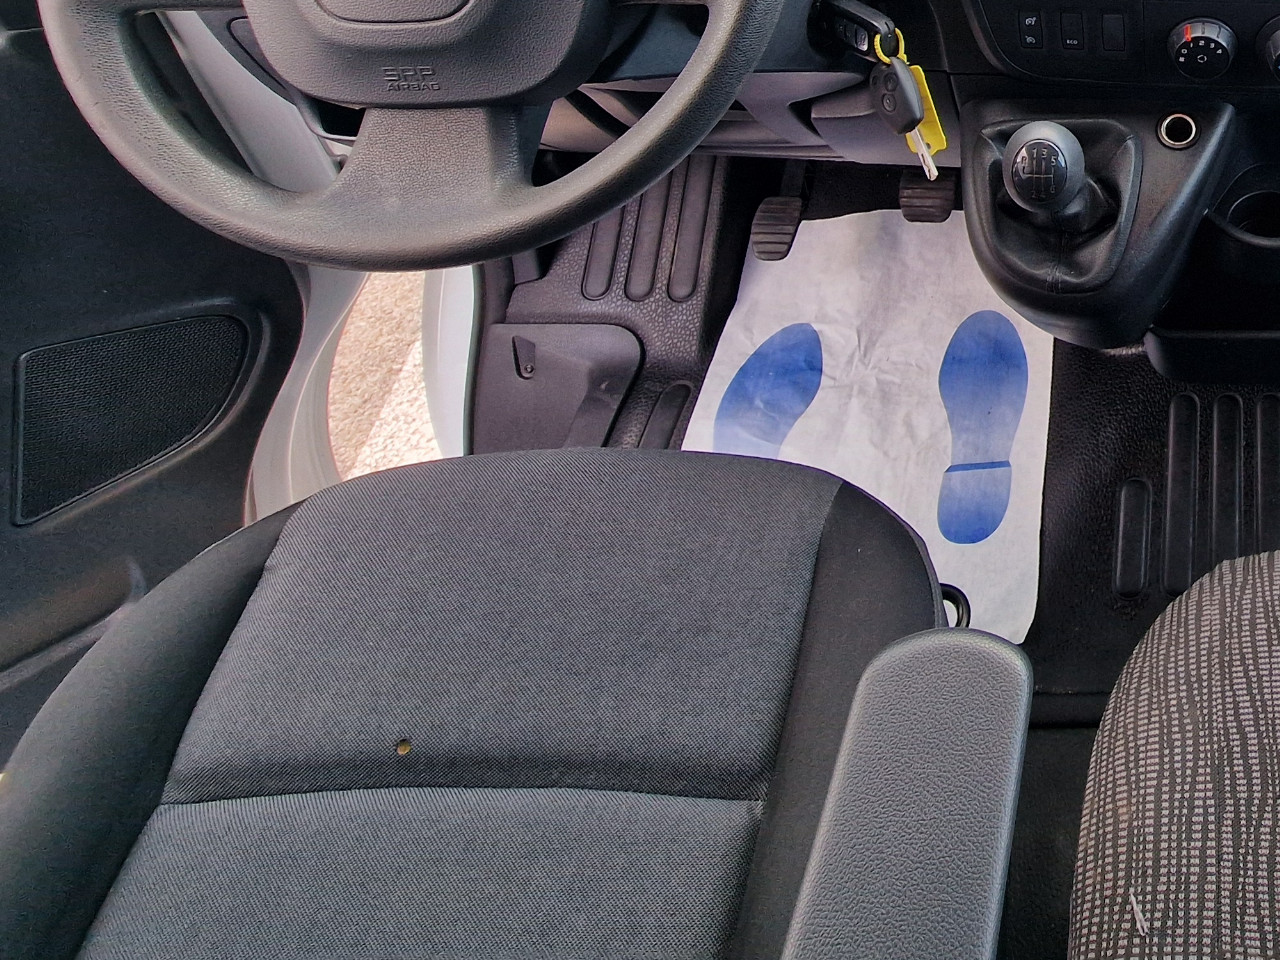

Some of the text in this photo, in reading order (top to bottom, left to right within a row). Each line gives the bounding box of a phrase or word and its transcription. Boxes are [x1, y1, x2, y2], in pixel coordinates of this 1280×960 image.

[387, 81, 440, 91] AIRBAG
[1032, 147, 1038, 158] 1
[1041, 148, 1048, 158] 3
[1051, 155, 1057, 166] 5
